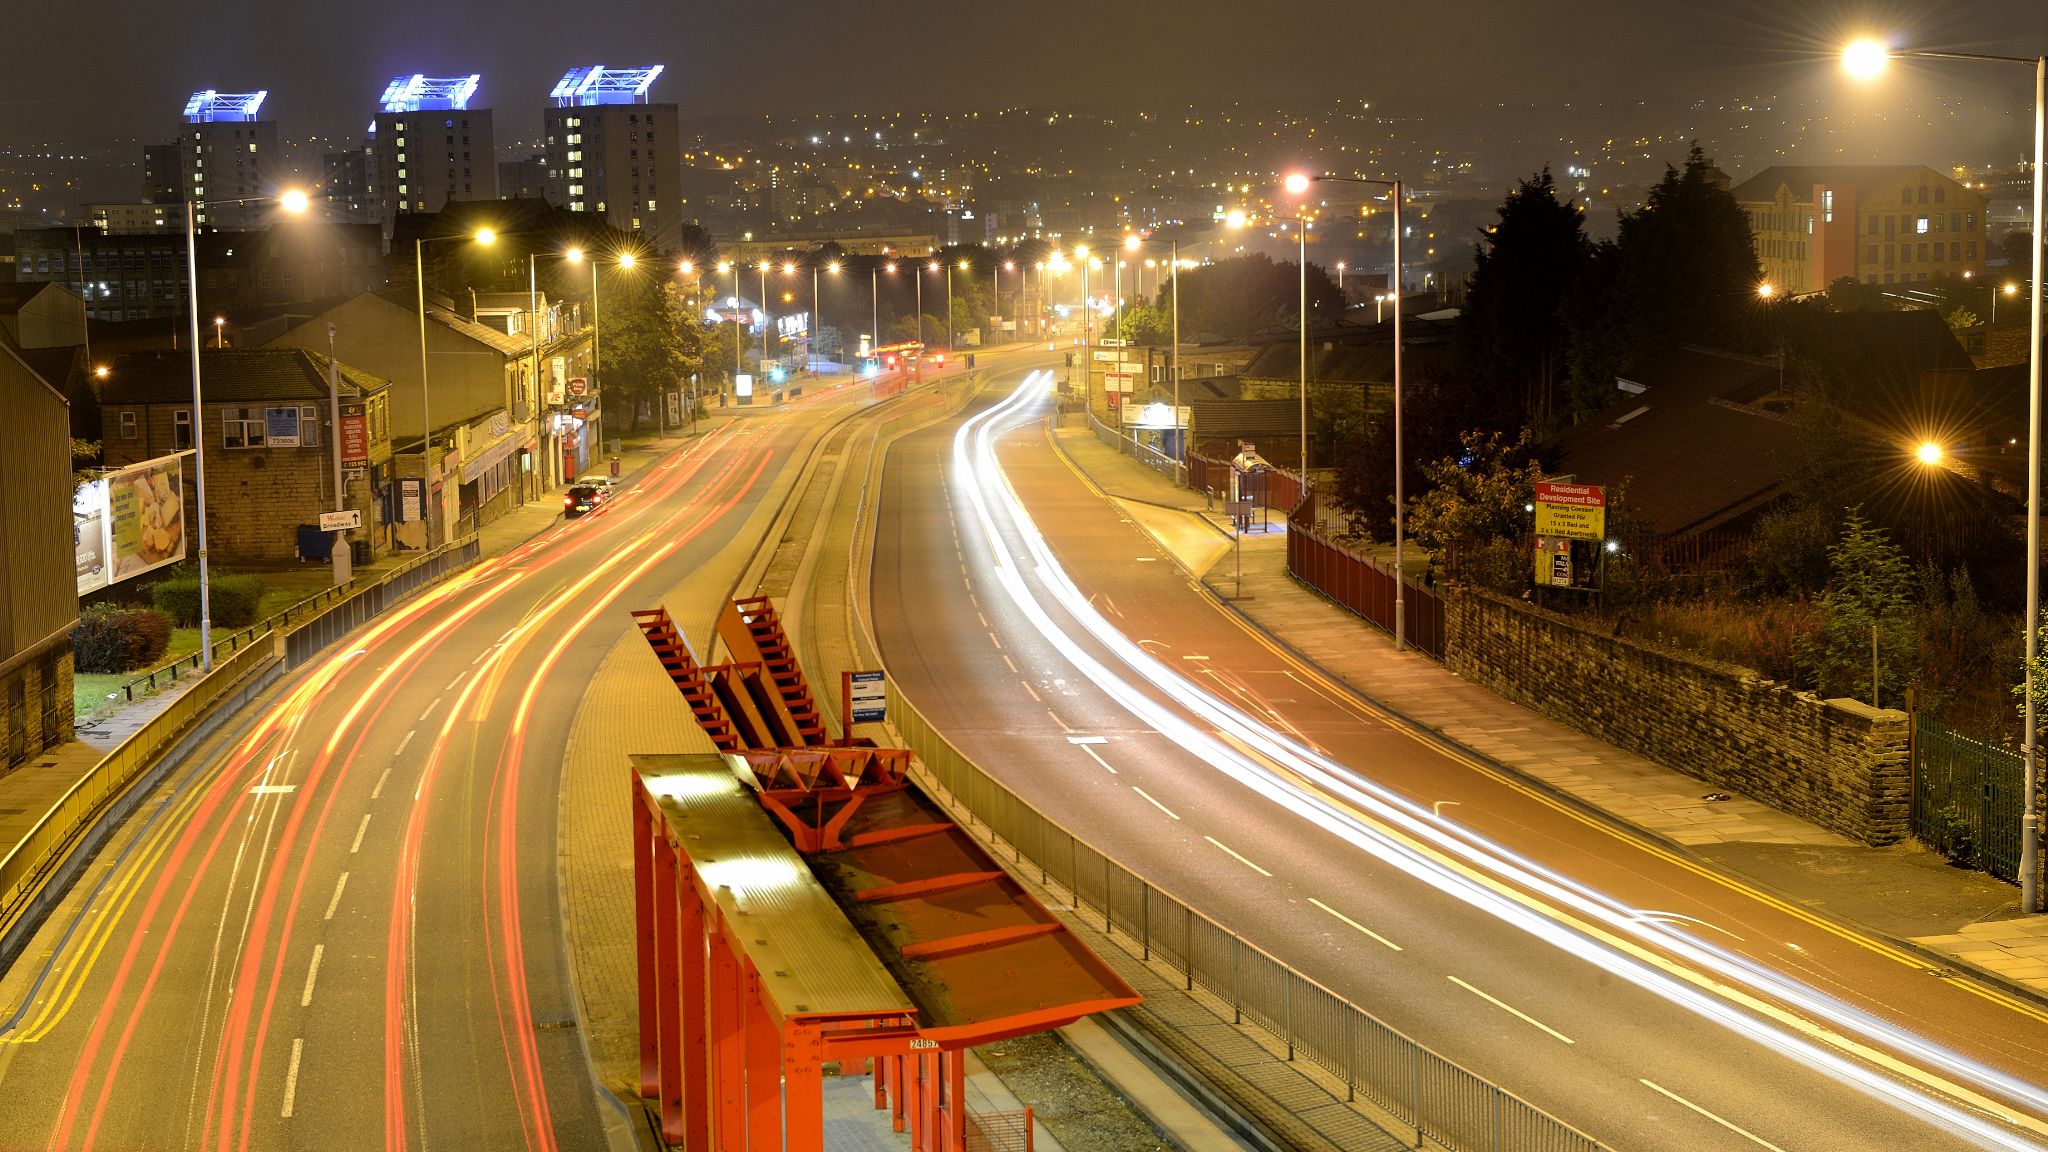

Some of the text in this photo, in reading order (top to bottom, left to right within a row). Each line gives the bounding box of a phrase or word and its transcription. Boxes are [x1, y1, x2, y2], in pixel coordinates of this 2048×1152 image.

[1550, 485, 1590, 495] Residential
[1540, 493, 1600, 504] Development Site
[1546, 504, 1569, 512] Planning
[1567, 530, 1598, 538] Apartments
[912, 1039, 938, 1048] 24857
